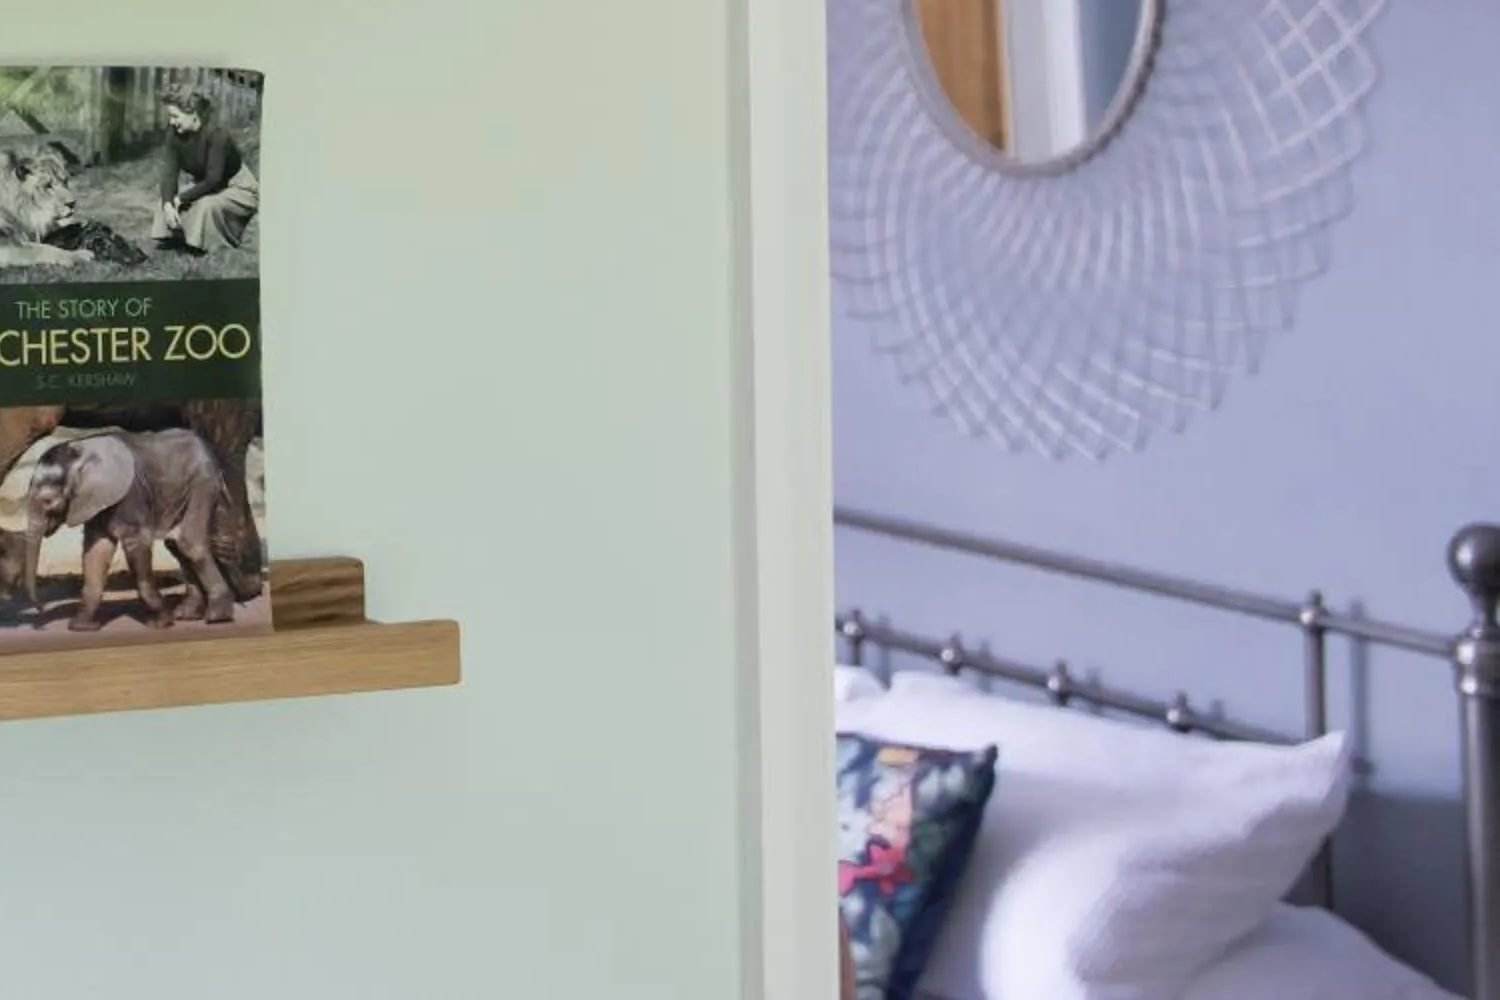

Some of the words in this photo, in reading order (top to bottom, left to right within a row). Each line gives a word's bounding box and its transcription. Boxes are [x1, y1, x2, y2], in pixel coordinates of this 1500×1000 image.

[16, 300, 51, 320] THE
[60, 298, 118, 319] STORY
[126, 297, 154, 317] OF
[164, 324, 251, 361] ZOO
[67, 373, 136, 388] KERSHAW
